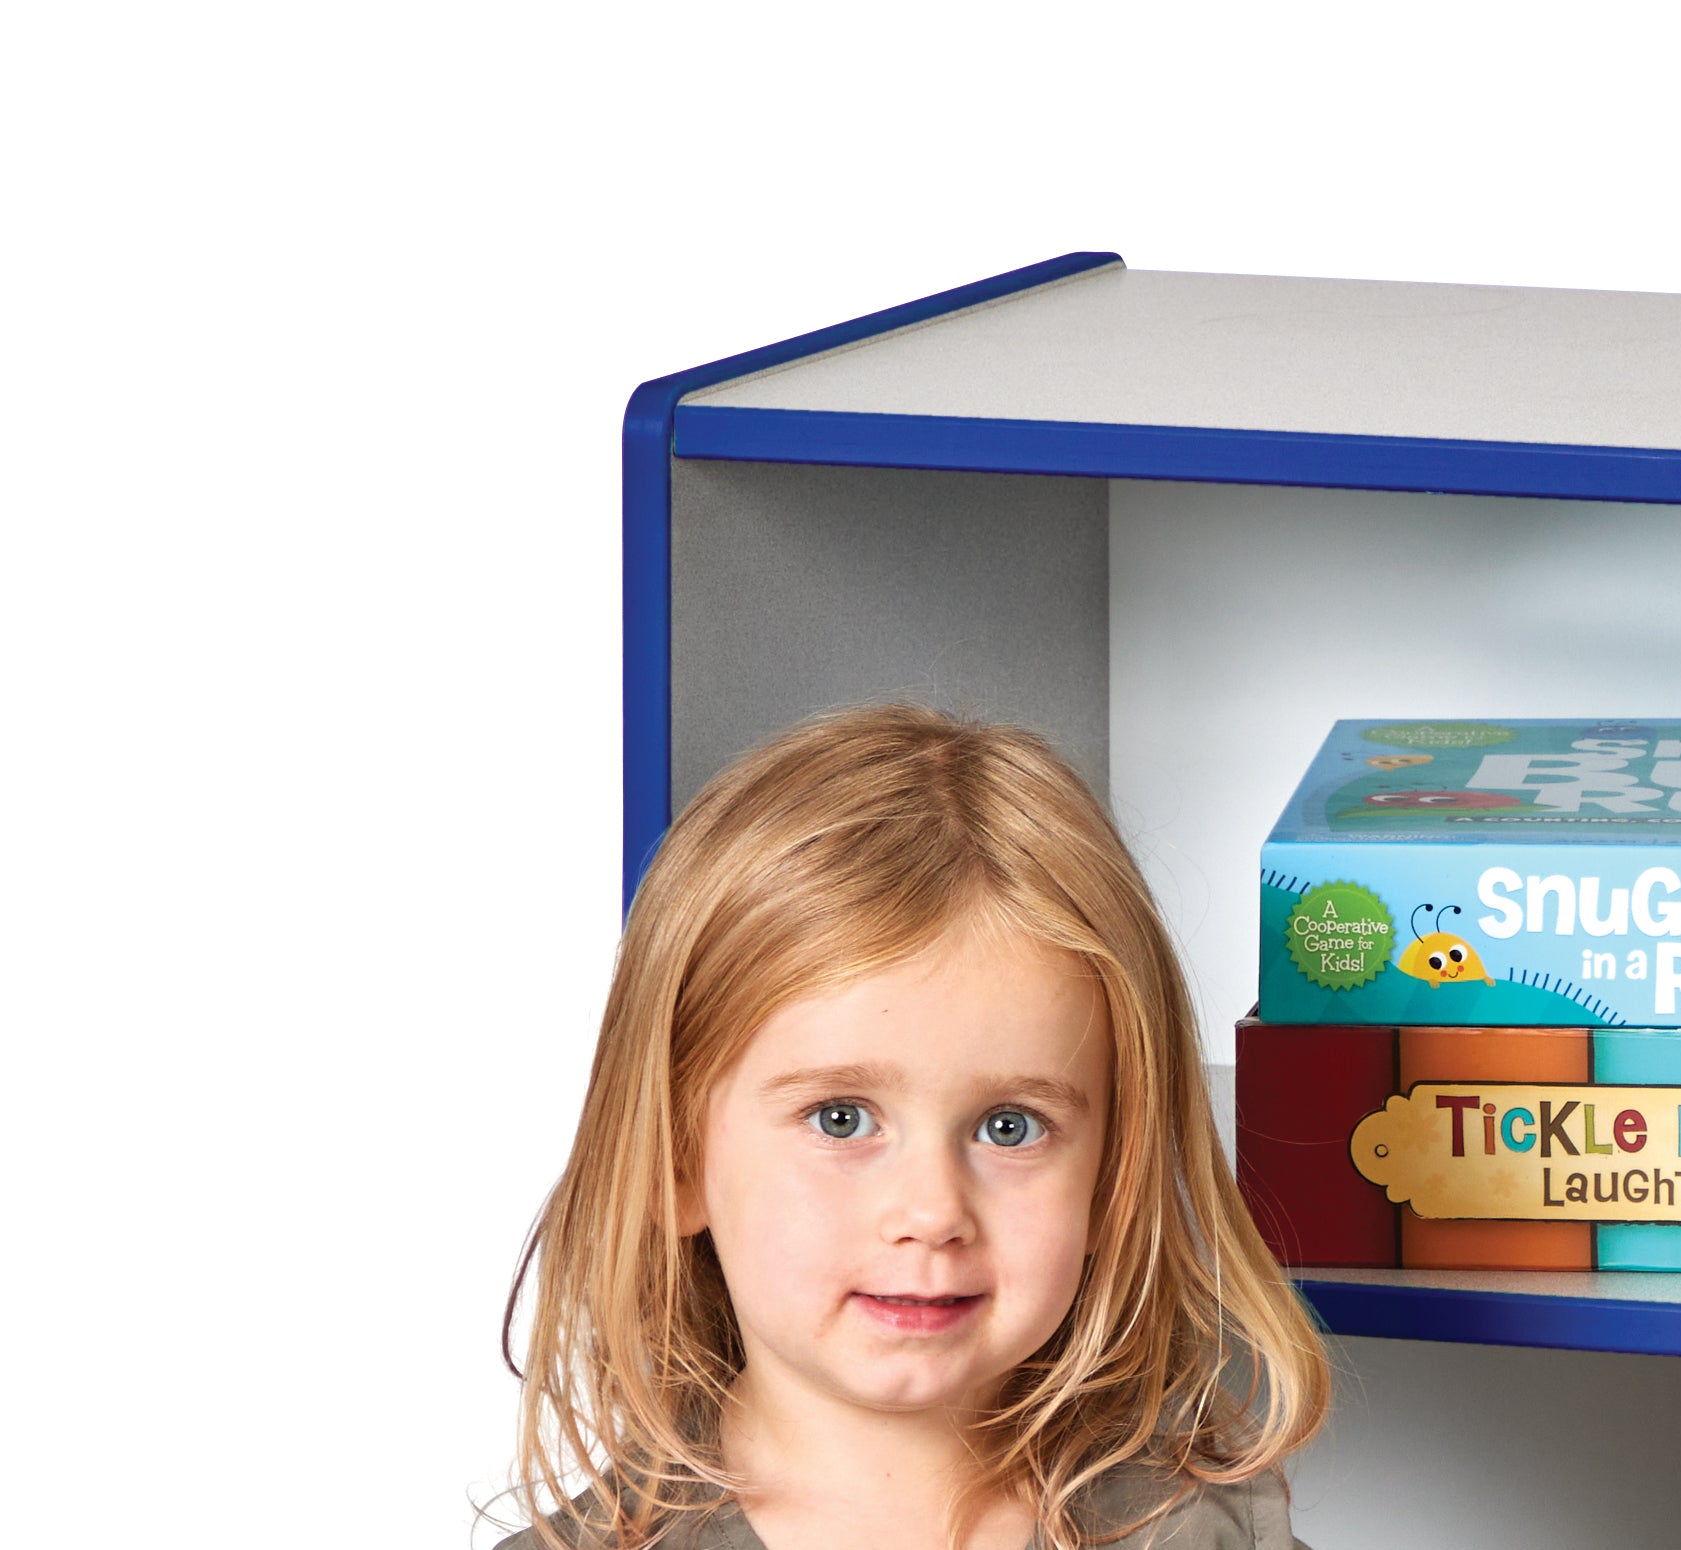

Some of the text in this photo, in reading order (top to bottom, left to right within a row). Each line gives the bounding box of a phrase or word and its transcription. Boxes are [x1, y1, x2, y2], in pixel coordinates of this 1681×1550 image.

[1322, 900, 1339, 919] A
[1293, 916, 1389, 936] Cooperative
[1304, 934, 1375, 952] Game for
[1320, 952, 1365, 972] Kids!
[1581, 948, 1617, 980] in
[1625, 950, 1647, 980] a
